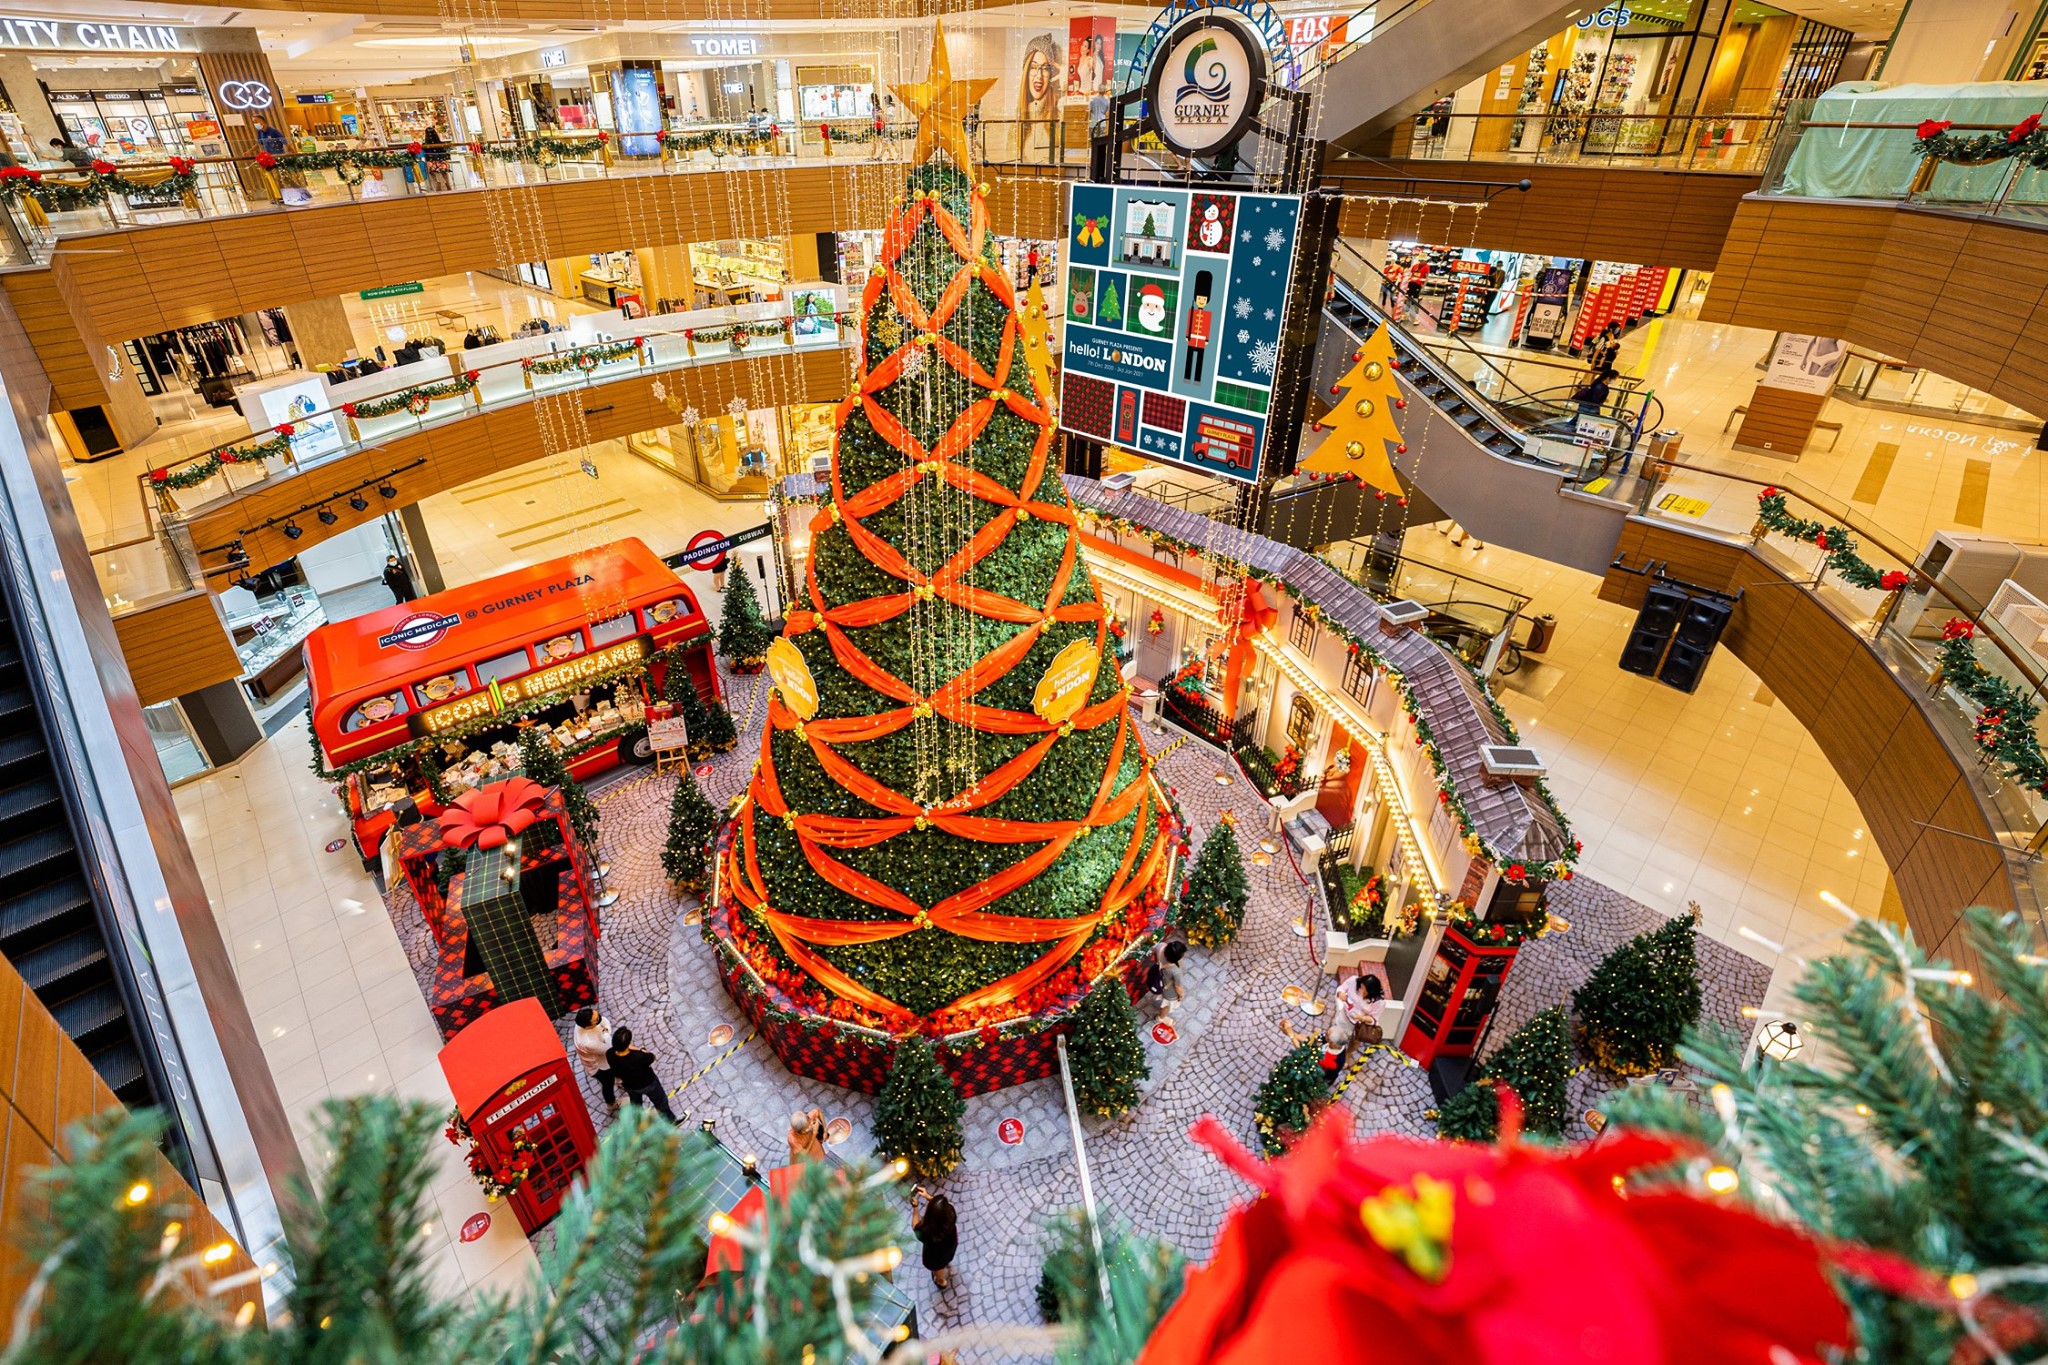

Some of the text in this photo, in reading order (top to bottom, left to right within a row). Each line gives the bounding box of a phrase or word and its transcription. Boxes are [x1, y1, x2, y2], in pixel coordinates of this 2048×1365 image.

[0, 20, 181, 50] ITY CHAIN
[691, 38, 757, 55] TOMEI
[541, 50, 566, 67] TOMEI
[723, 82, 744, 94] TOMEI
[1174, 104, 1230, 117] GURNEY
[1456, 261, 1486, 273] SALE
[1069, 340, 1167, 373] hello! LONDON
[1092, 338, 1109, 346] GURNEY
[1122, 344, 1143, 353] PRESENTS
[1094, 361, 1103, 369] Dec
[1206, 429, 1237, 441] GURNEY PLAZA
[683, 540, 731, 562] PADDINGTON
[738, 528, 765, 543] SUBWAY
[465, 574, 595, 620] @ GURNEY PLAZA
[380, 616, 459, 645] ICONIC MEDICARE
[524, 642, 642, 697] MEDICARE
[1054, 665, 1080, 689] hello!
[140, 971, 187, 1100] GETHA
[490, 1077, 556, 1122] TELEPHONE
